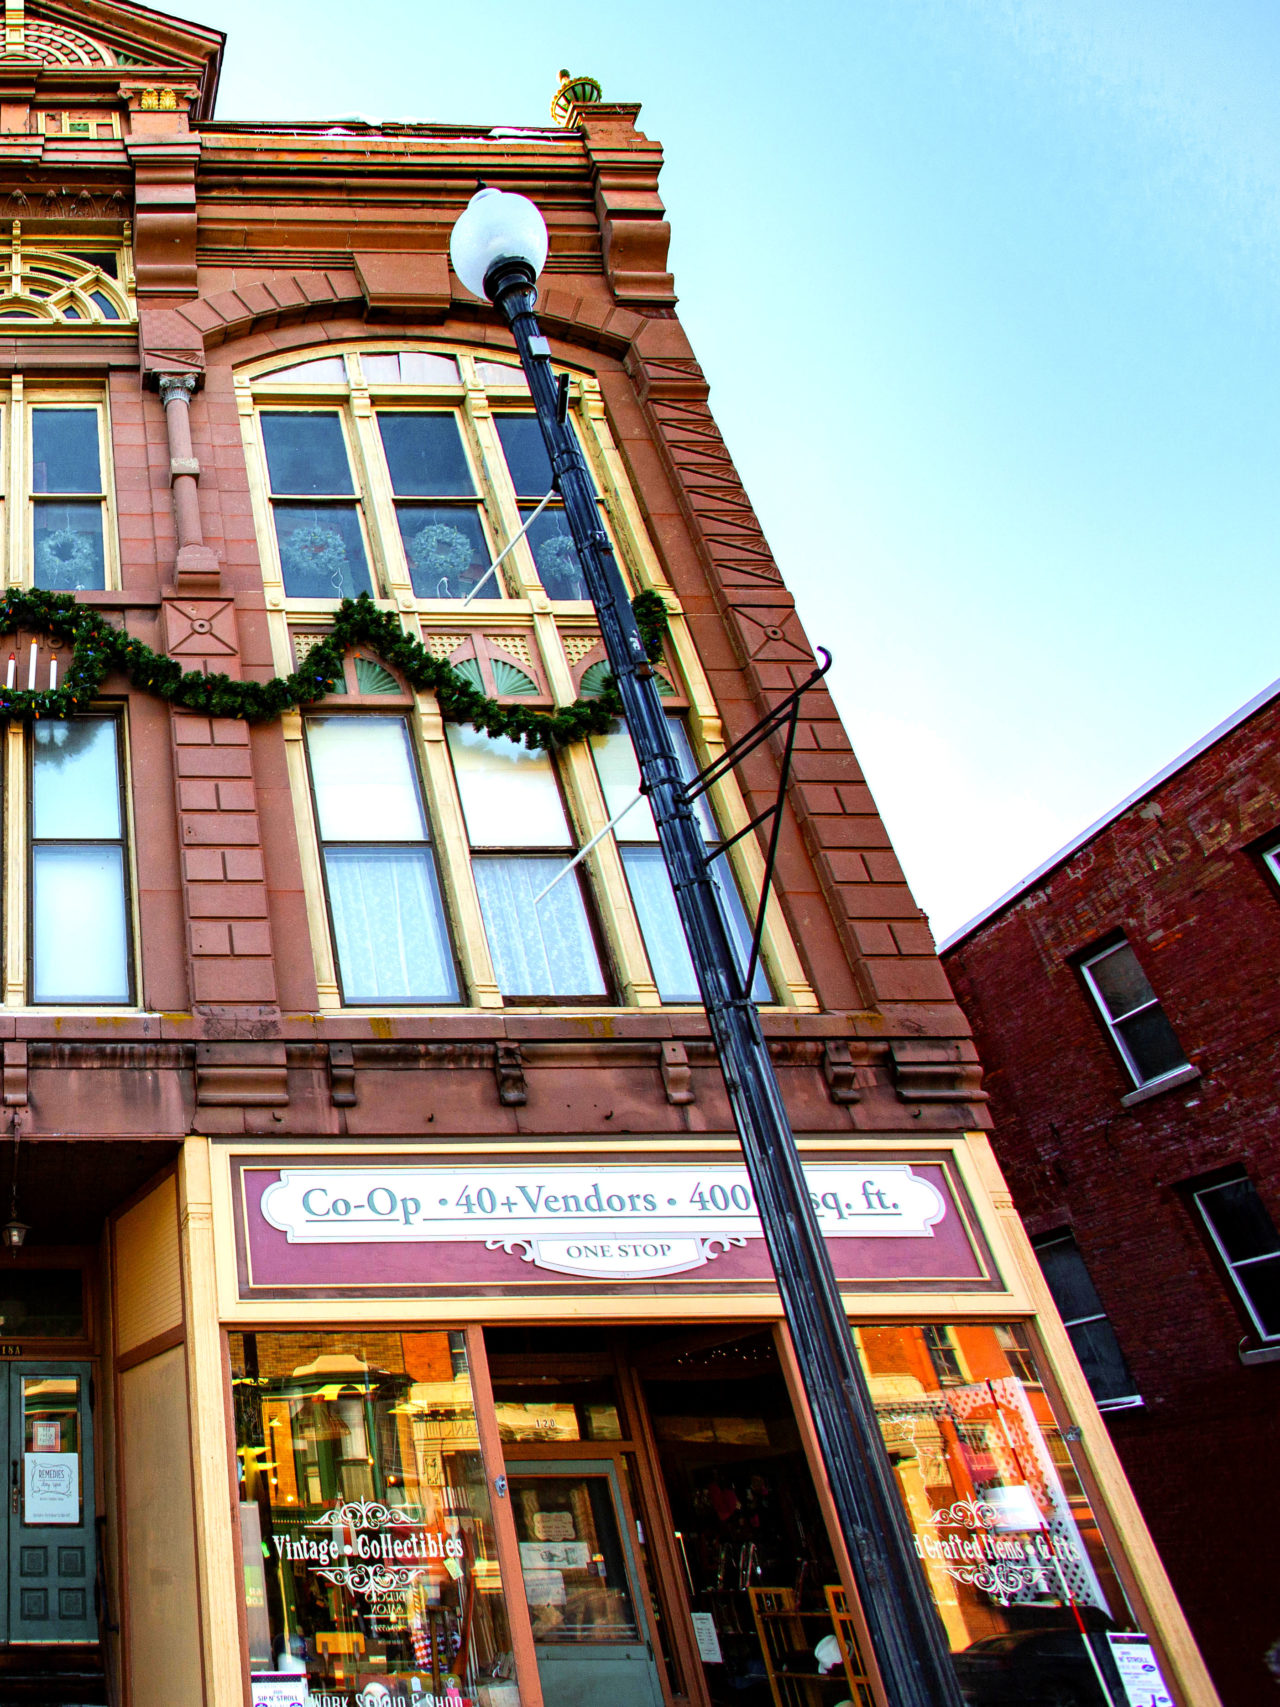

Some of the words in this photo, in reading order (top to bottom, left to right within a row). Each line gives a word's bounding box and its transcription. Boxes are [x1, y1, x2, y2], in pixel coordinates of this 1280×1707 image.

[302, 1186, 422, 1226] Co-Op
[689, 1182, 754, 1212] 400
[861, 1180, 900, 1210] ft.
[566, 1243, 614, 1259] ONE
[617, 1243, 672, 1259] STOP
[535, 1418, 555, 1428] 120
[38, 1469, 65, 1479] REMEDIES
[272, 1535, 339, 1565] Vintage
[357, 1533, 464, 1559] Collectibles
[923, 1534, 983, 1559] Crafted
[981, 1534, 1027, 1560] Items
[1035, 1534, 1081, 1562] Gfts
